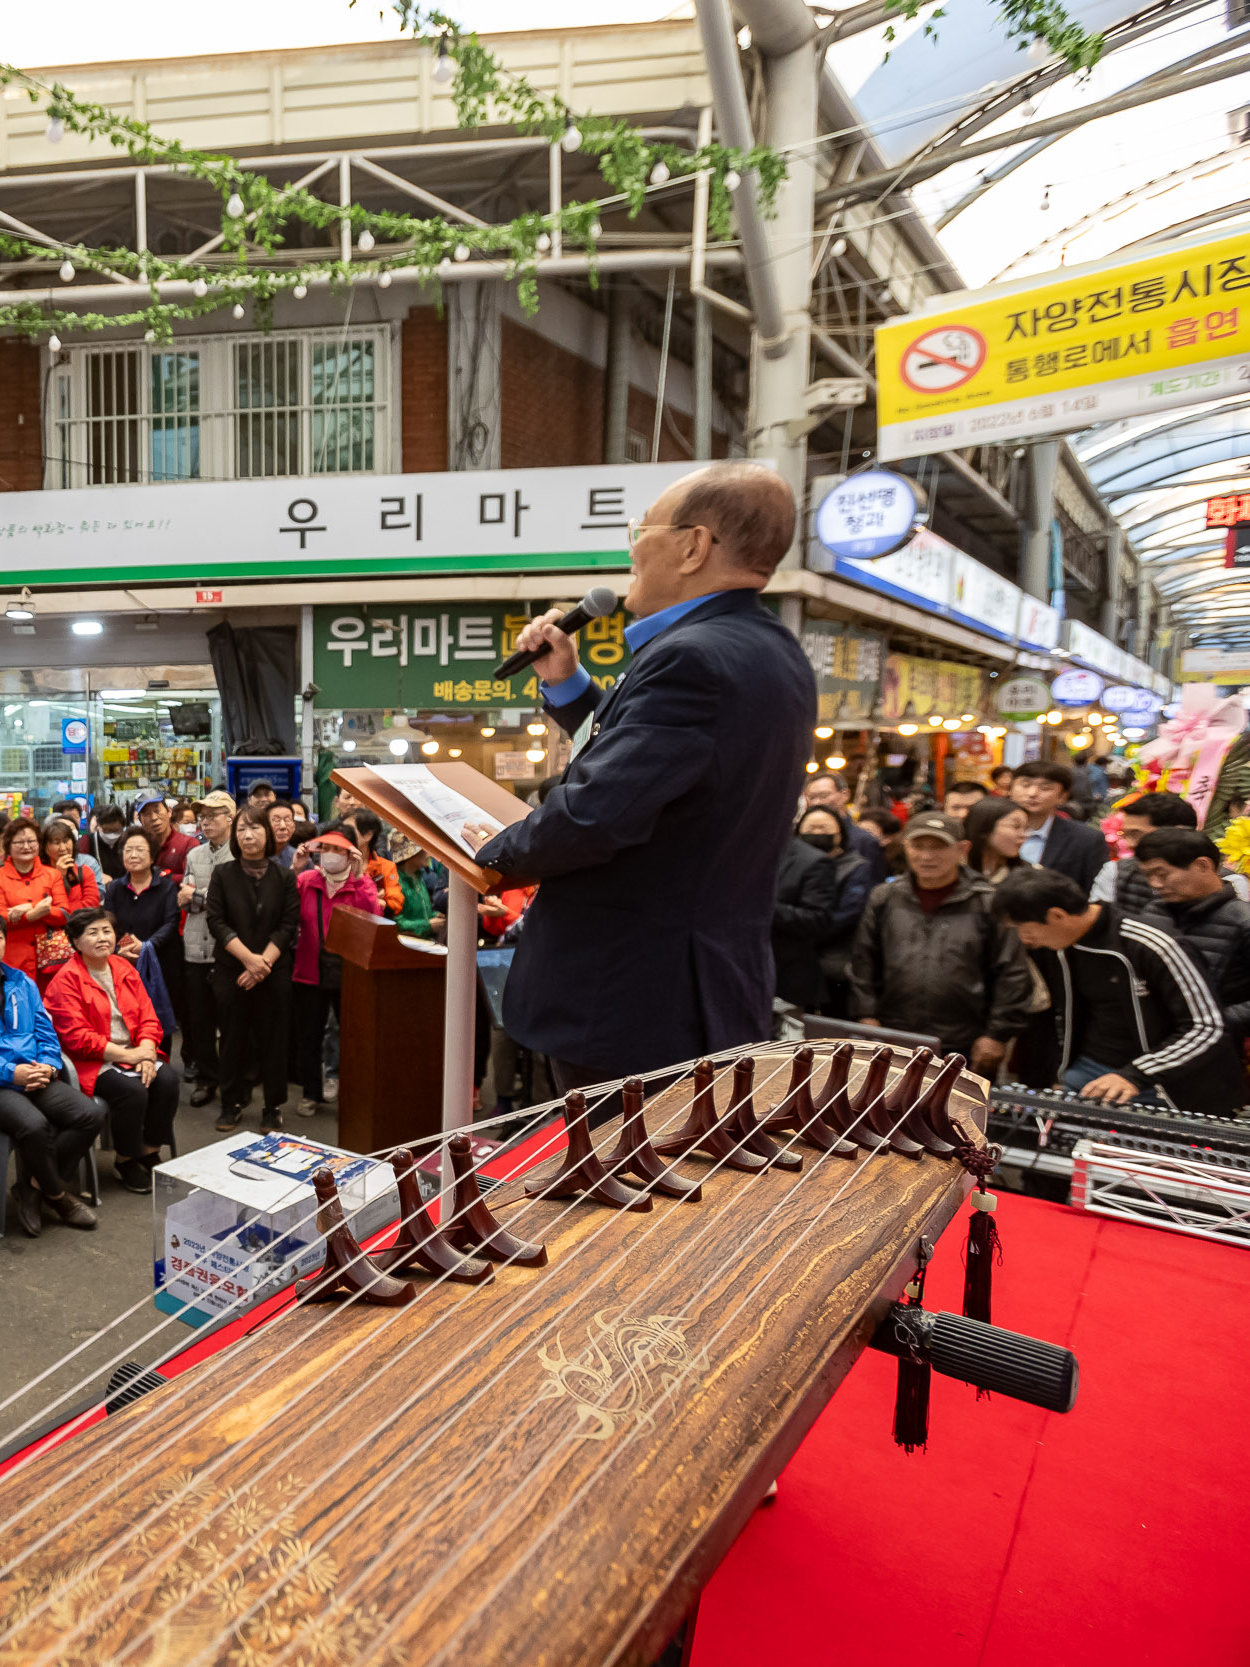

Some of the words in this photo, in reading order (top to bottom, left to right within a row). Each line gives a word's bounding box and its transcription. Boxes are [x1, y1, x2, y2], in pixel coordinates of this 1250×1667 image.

[1006, 330, 1152, 383] 통행로에서
[1166, 307, 1239, 350] 흡연
[279, 487, 629, 549] 우리마트
[327, 614, 497, 668] 우리마트
